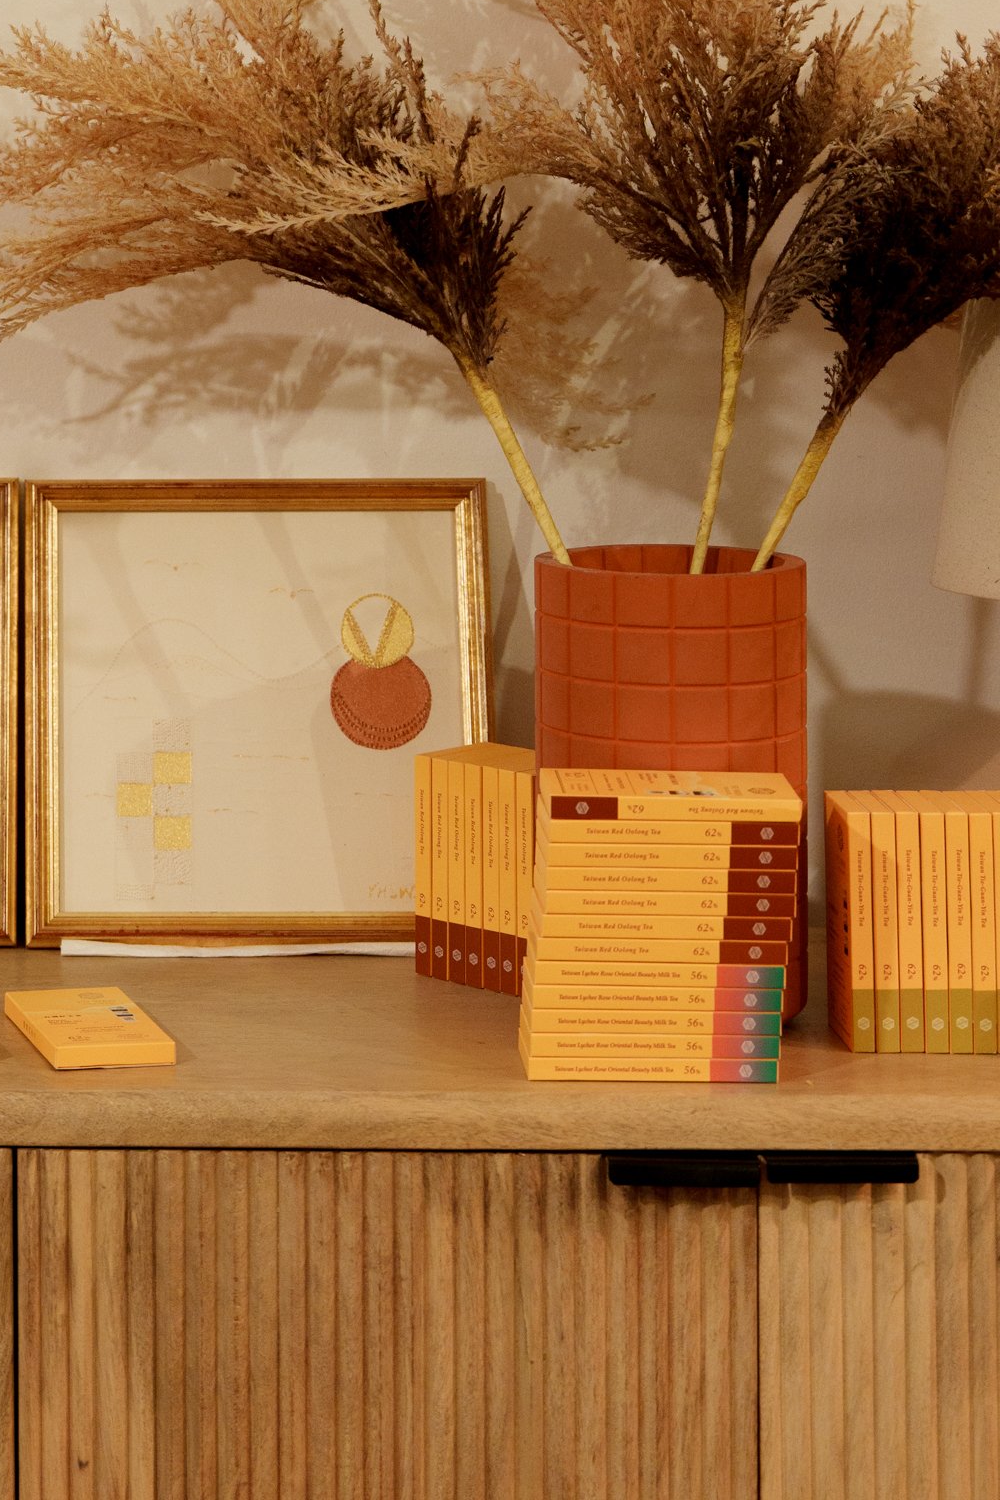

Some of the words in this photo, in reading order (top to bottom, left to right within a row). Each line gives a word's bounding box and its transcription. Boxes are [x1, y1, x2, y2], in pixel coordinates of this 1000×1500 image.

[725, 805, 739, 814] Red
[586, 827, 610, 835] Taiwan
[611, 827, 624, 835] Red
[624, 828, 649, 837] Oolong
[650, 828, 662, 836] Tea
[623, 852, 647, 861] Oolong
[649, 852, 660, 860] Tea
[905, 849, 913, 872] Taiwan
[955, 849, 963, 872] Taiwan
[621, 875, 646, 884] Oolong
[647, 875, 658, 883] Tea
[582, 898, 606, 906] Taiwan
[620, 899, 645, 908] Oolong
[646, 899, 658, 907] Tea
[578, 922, 602, 930] Taiwan
[603, 922, 616, 930] Red
[617, 923, 641, 932] Oolong
[932, 916, 940, 928] Tea
[574, 945, 598, 953] Taiwan
[612, 946, 637, 955] Oolong
[638, 946, 650, 954] Tea
[637, 971, 657, 979] Beauty
[671, 971, 681, 979] Tea
[635, 994, 655, 1003] Beauty
[633, 1019, 653, 1027] Beauty
[633, 1042, 653, 1051] Beauty
[593, 1065, 607, 1073] Rose
[630, 1066, 650, 1075] Beauty
